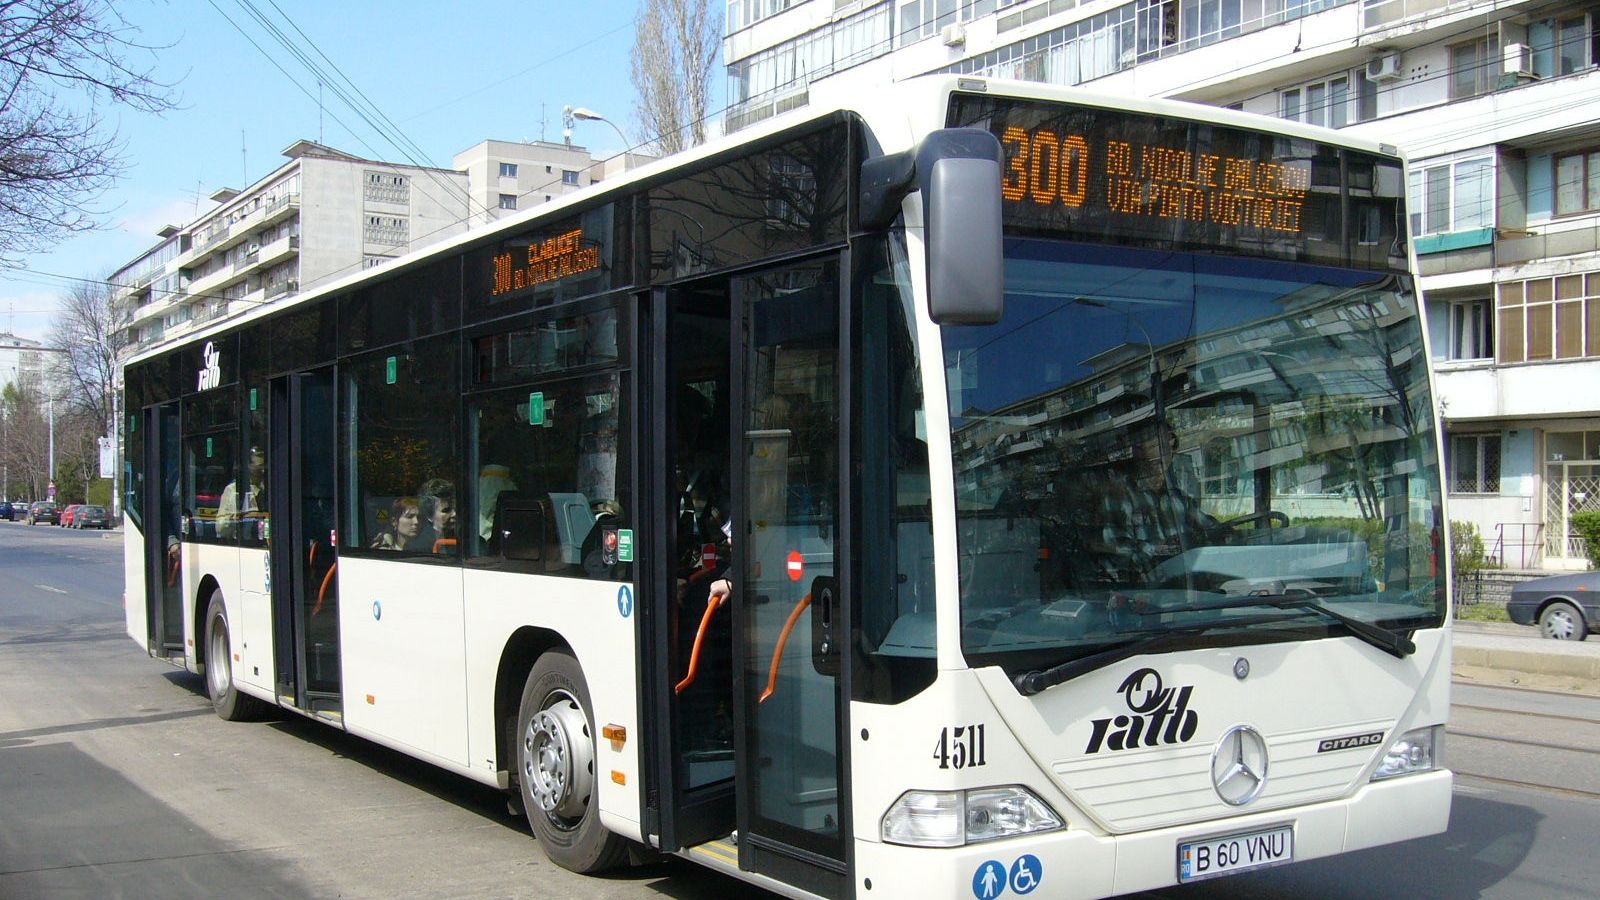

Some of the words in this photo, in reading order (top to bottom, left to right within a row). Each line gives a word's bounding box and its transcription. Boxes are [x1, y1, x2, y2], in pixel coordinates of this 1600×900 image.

[1003, 126, 1088, 207] 300
[1107, 141, 1134, 175] BD.
[1141, 145, 1219, 187] NICOLAE
[1224, 158, 1306, 198] BALCESCU
[1107, 178, 1142, 213] VIA
[1149, 183, 1204, 221] PIATA
[1210, 191, 1303, 232] VICTORIEI
[492, 253, 512, 295] 300
[933, 723, 986, 769] 4511
[1321, 734, 1382, 750] CITARO
[1197, 846, 1210, 872] B
[1217, 841, 1240, 868] 60
[1246, 832, 1284, 862] VNU
